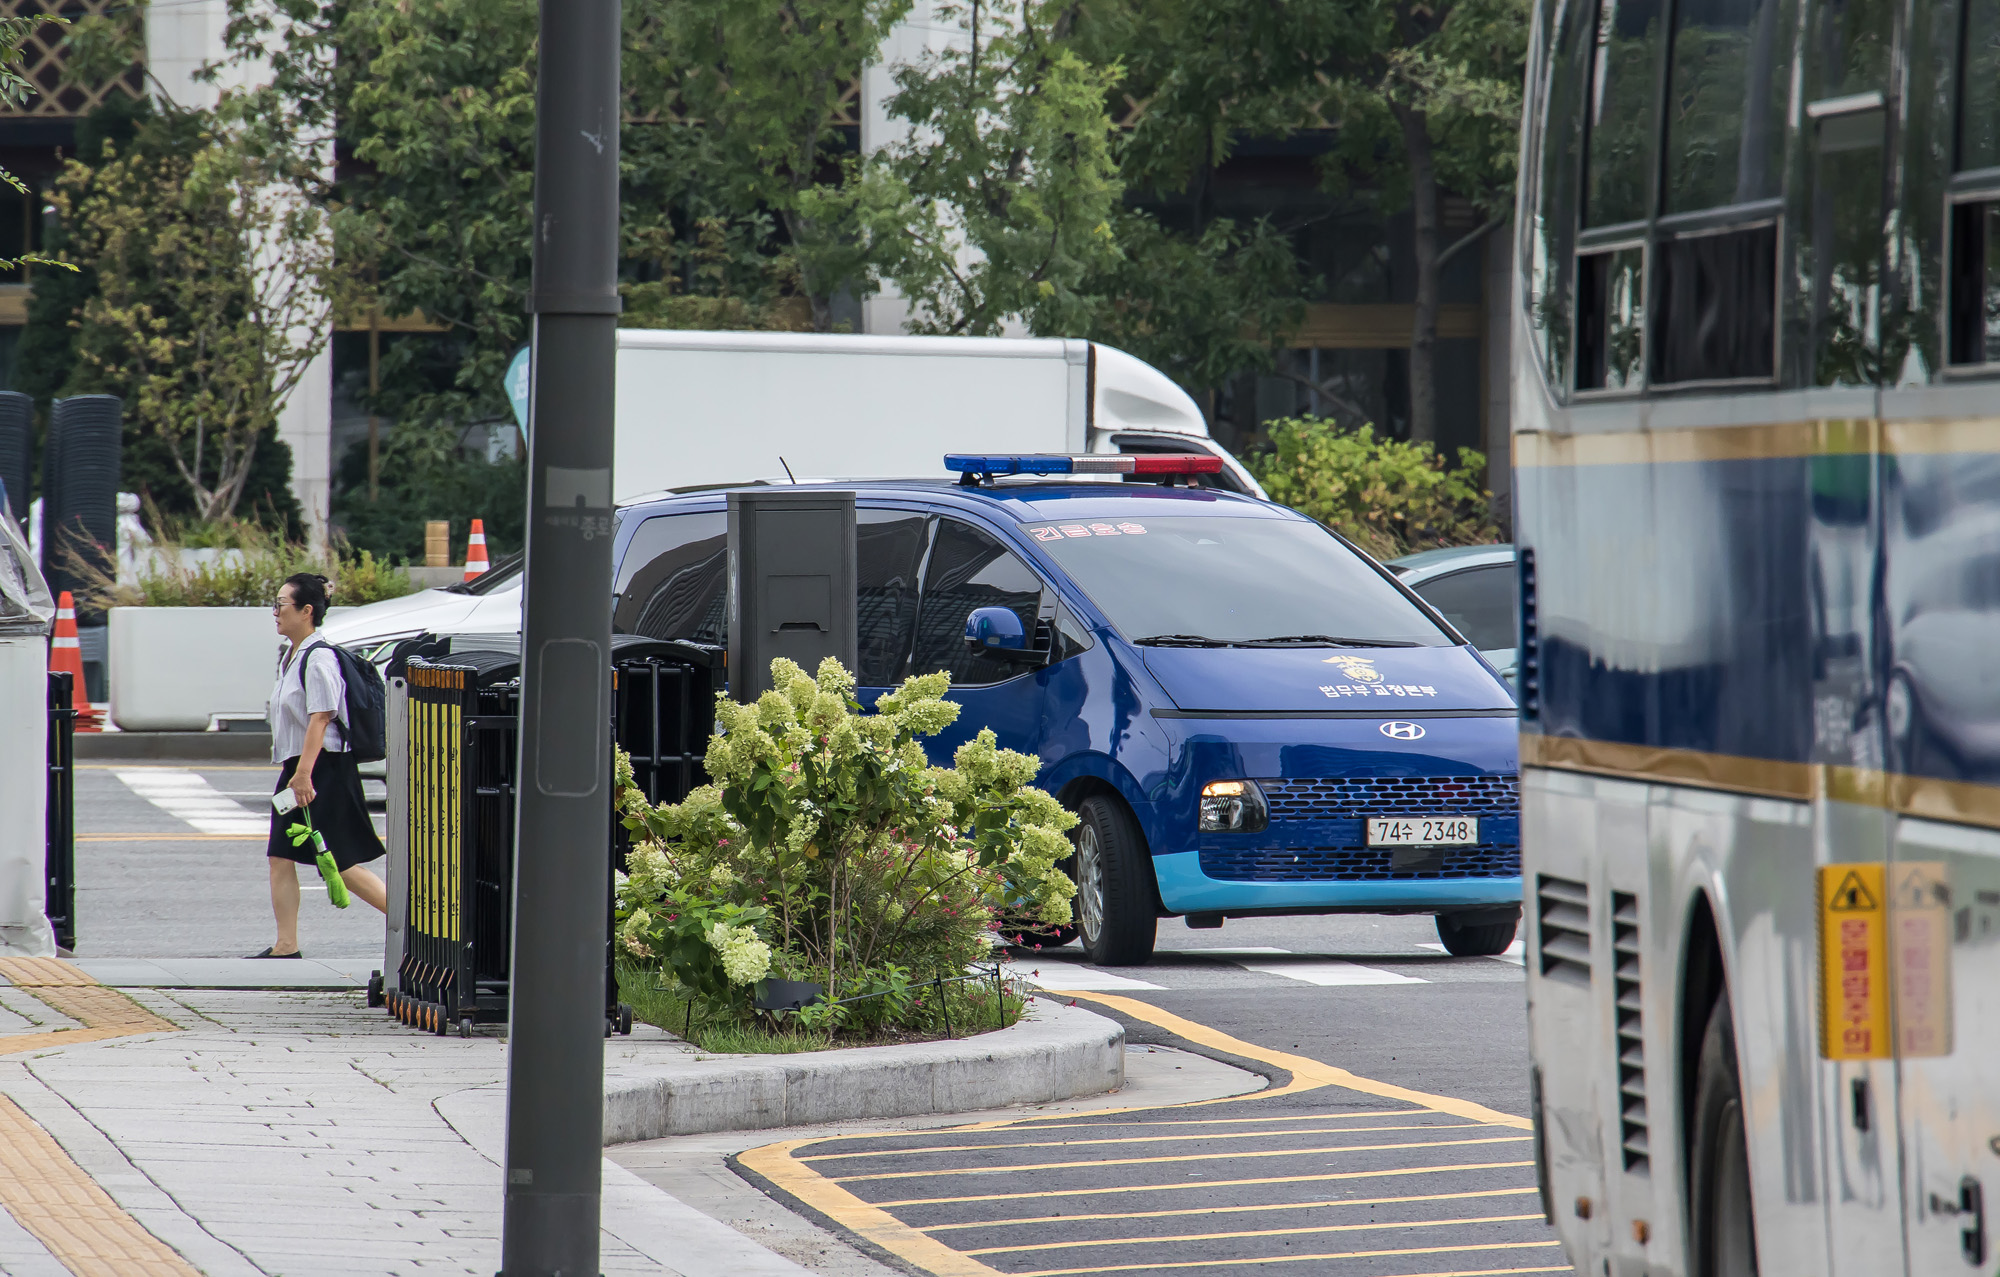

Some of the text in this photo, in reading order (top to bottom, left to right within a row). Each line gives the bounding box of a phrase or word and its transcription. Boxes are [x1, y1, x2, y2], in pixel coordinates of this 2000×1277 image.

[578, 516, 610, 541] 종로
[1030, 521, 1148, 542] 긴급호송
[1378, 821, 1468, 841] 74수 2348
